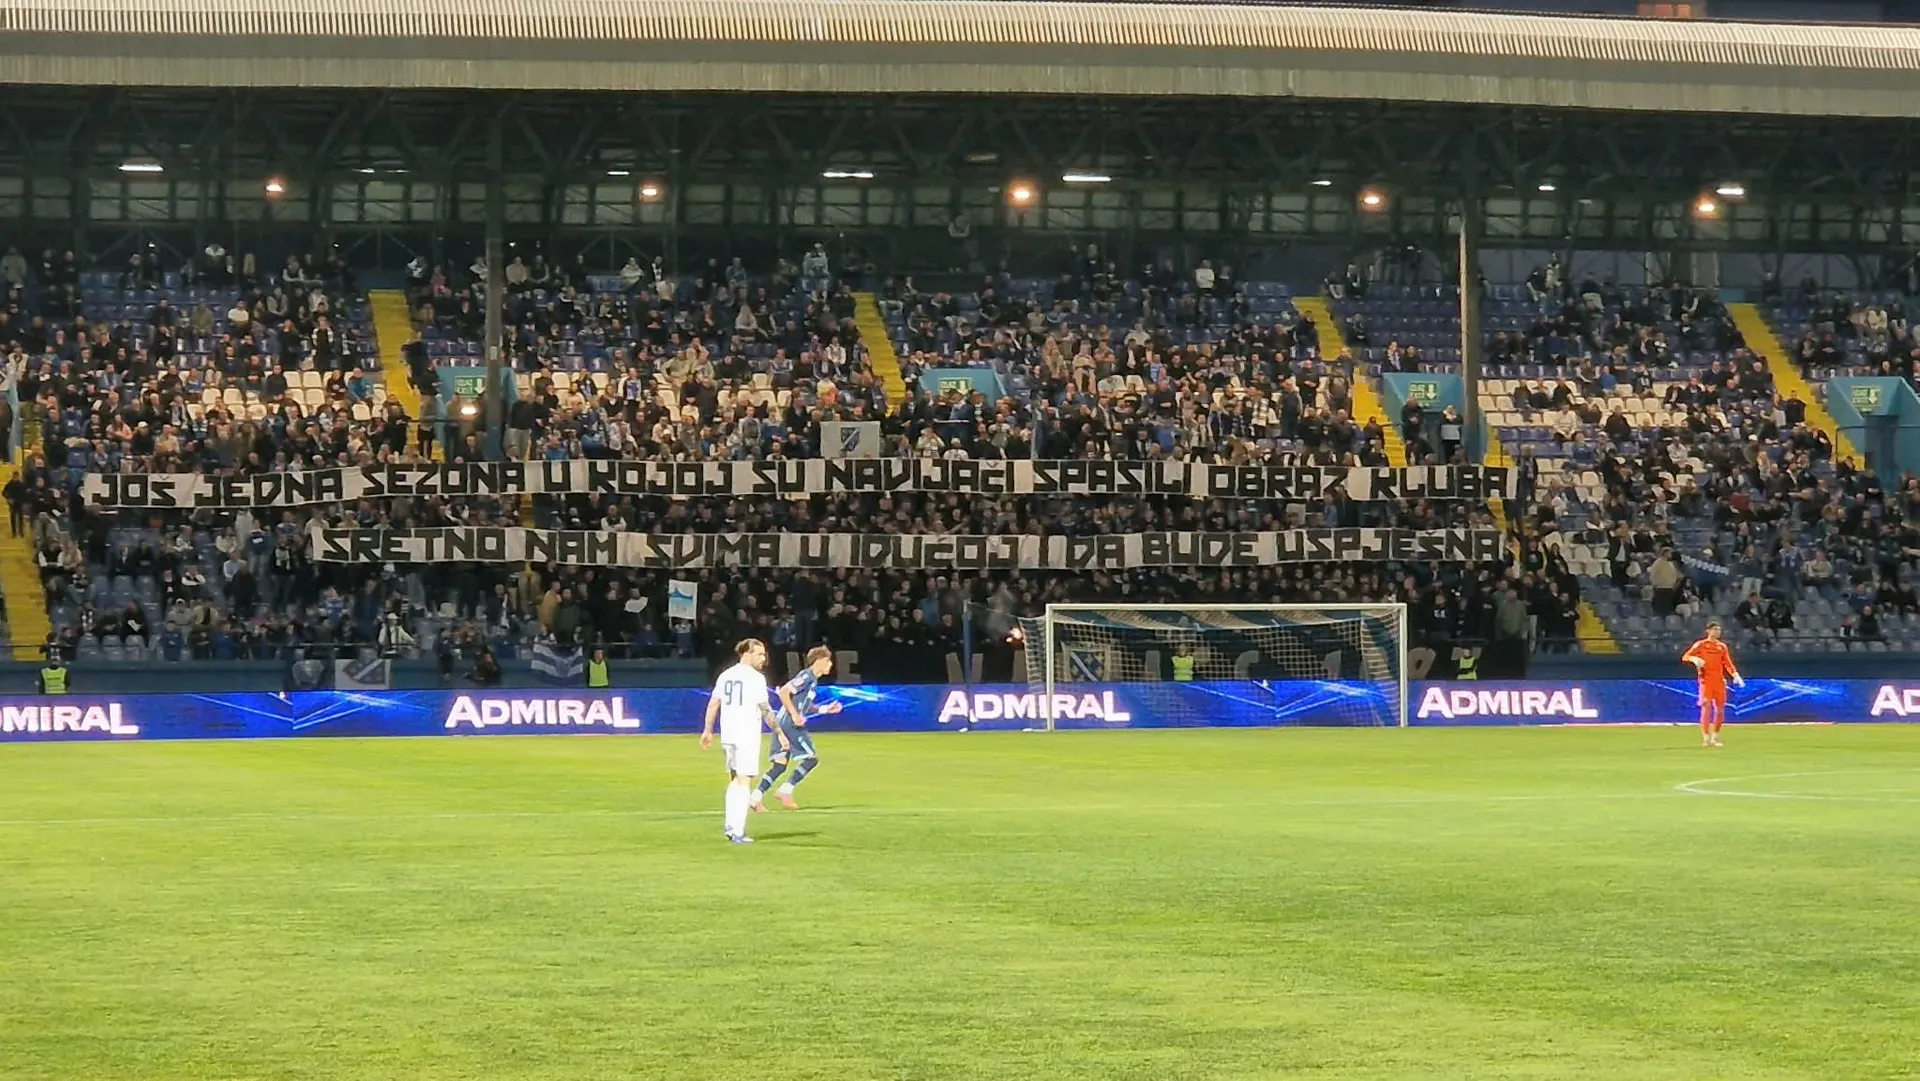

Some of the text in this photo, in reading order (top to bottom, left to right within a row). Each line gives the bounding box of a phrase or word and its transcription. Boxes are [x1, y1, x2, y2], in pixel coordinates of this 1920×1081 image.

[92, 458, 1508, 506] JOŠ JEDNA SEZONA U KOJOJ SU NAVIJAČI SPASILI OBRAZ KLUBA
[322, 528, 506, 560] SRETNO
[525, 530, 618, 564] NAM
[645, 533, 780, 567] SVIMA
[800, 535, 830, 566] U
[1039, 535, 1049, 567] I
[1066, 535, 1125, 568] DA
[1142, 531, 1259, 565] BUDE
[1276, 528, 1501, 561] USPJEŠNA
[724, 680, 743, 706] 97
[938, 690, 1131, 723] ADMIRAL
[1417, 687, 1599, 718] ADMIRAL
[0, 703, 139, 734] MIRAL
[445, 695, 640, 728] ADMIRAL
